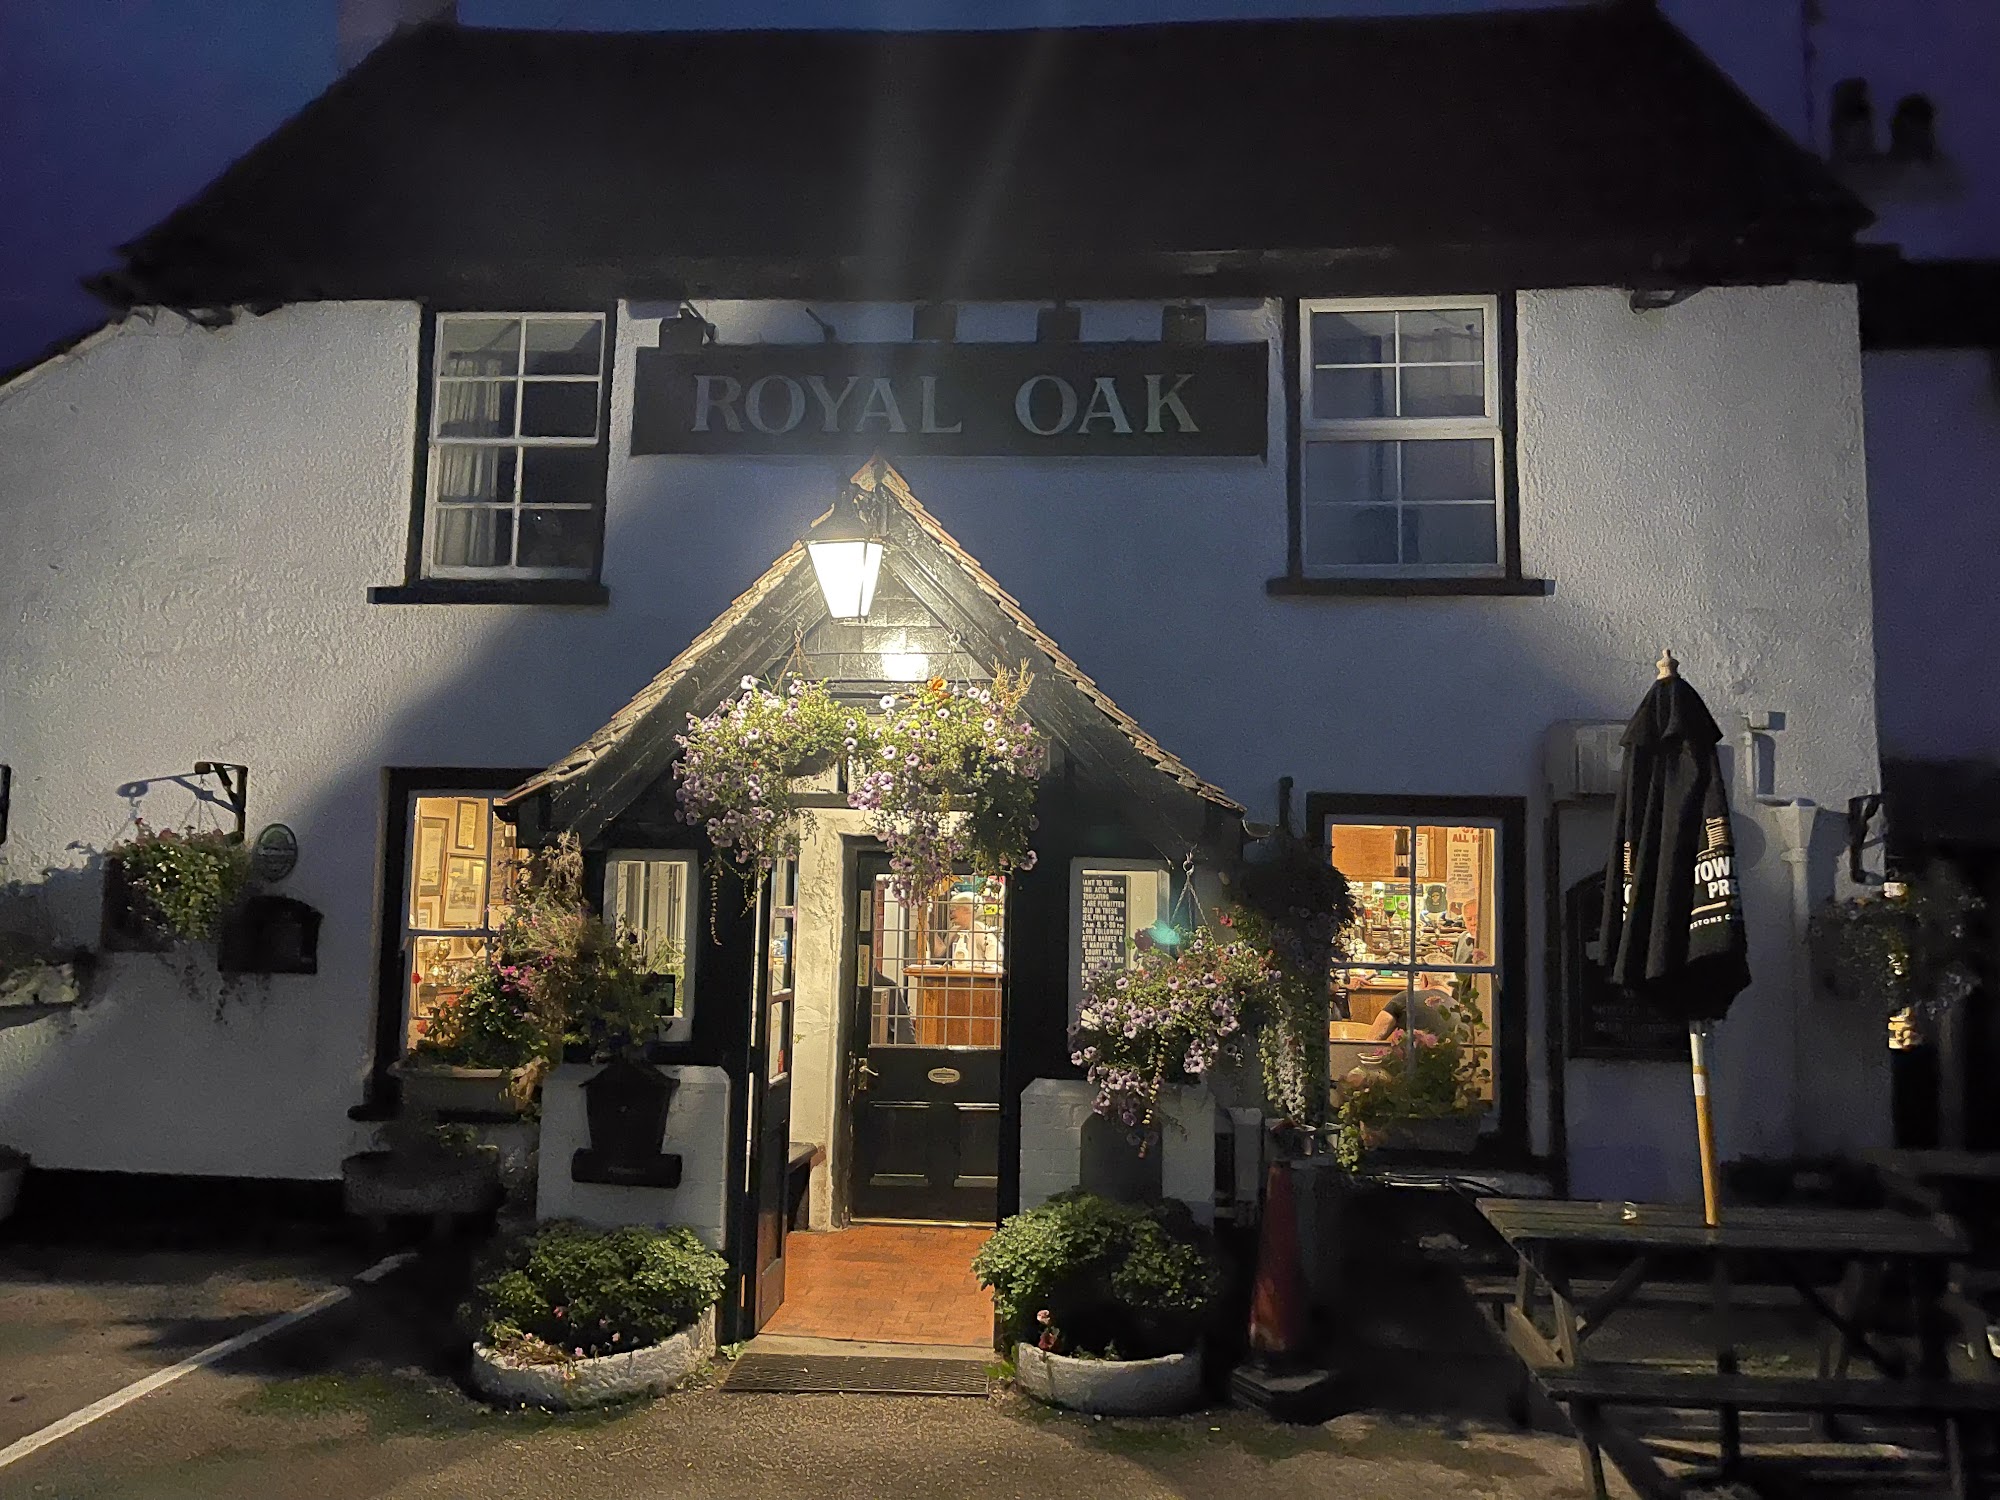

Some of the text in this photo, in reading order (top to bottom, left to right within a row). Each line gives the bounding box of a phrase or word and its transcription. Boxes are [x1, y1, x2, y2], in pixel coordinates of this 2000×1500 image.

[690, 374, 1201, 434] ROYAL OAK
[1452, 834, 1470, 843] ALL
[1694, 856, 1730, 885] TOW
[1707, 879, 1731, 899] PR
[1085, 955, 1113, 963] CHRISTMAS
